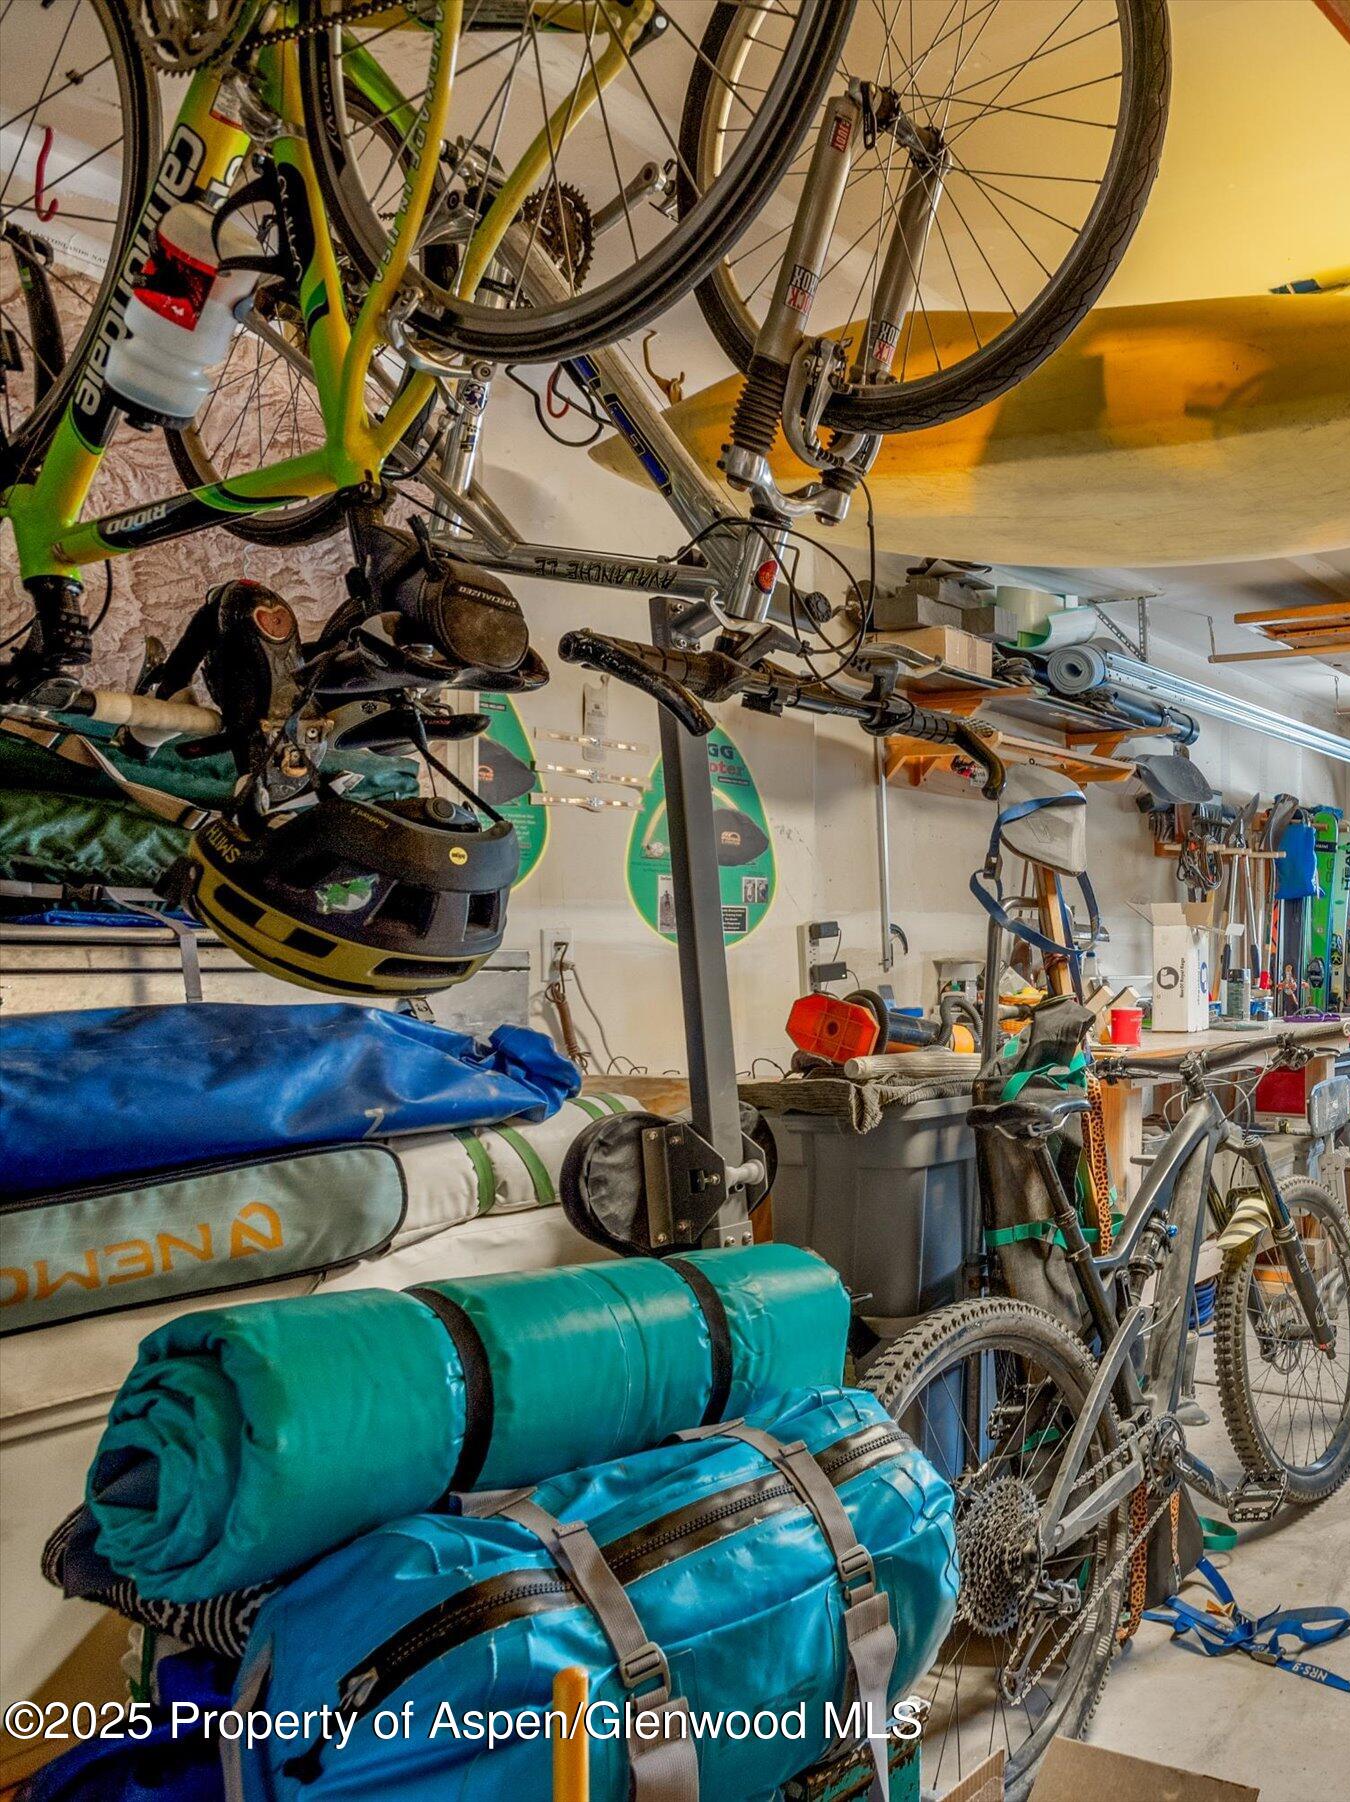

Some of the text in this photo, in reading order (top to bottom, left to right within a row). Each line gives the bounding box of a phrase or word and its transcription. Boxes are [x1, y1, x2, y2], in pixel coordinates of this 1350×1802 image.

[105, 503, 167, 535] R1000
[534, 556, 678, 590] AVALANCHE LE
[459, 585, 518, 608] SPECIALIZED
[203, 824, 241, 864] SMITH
